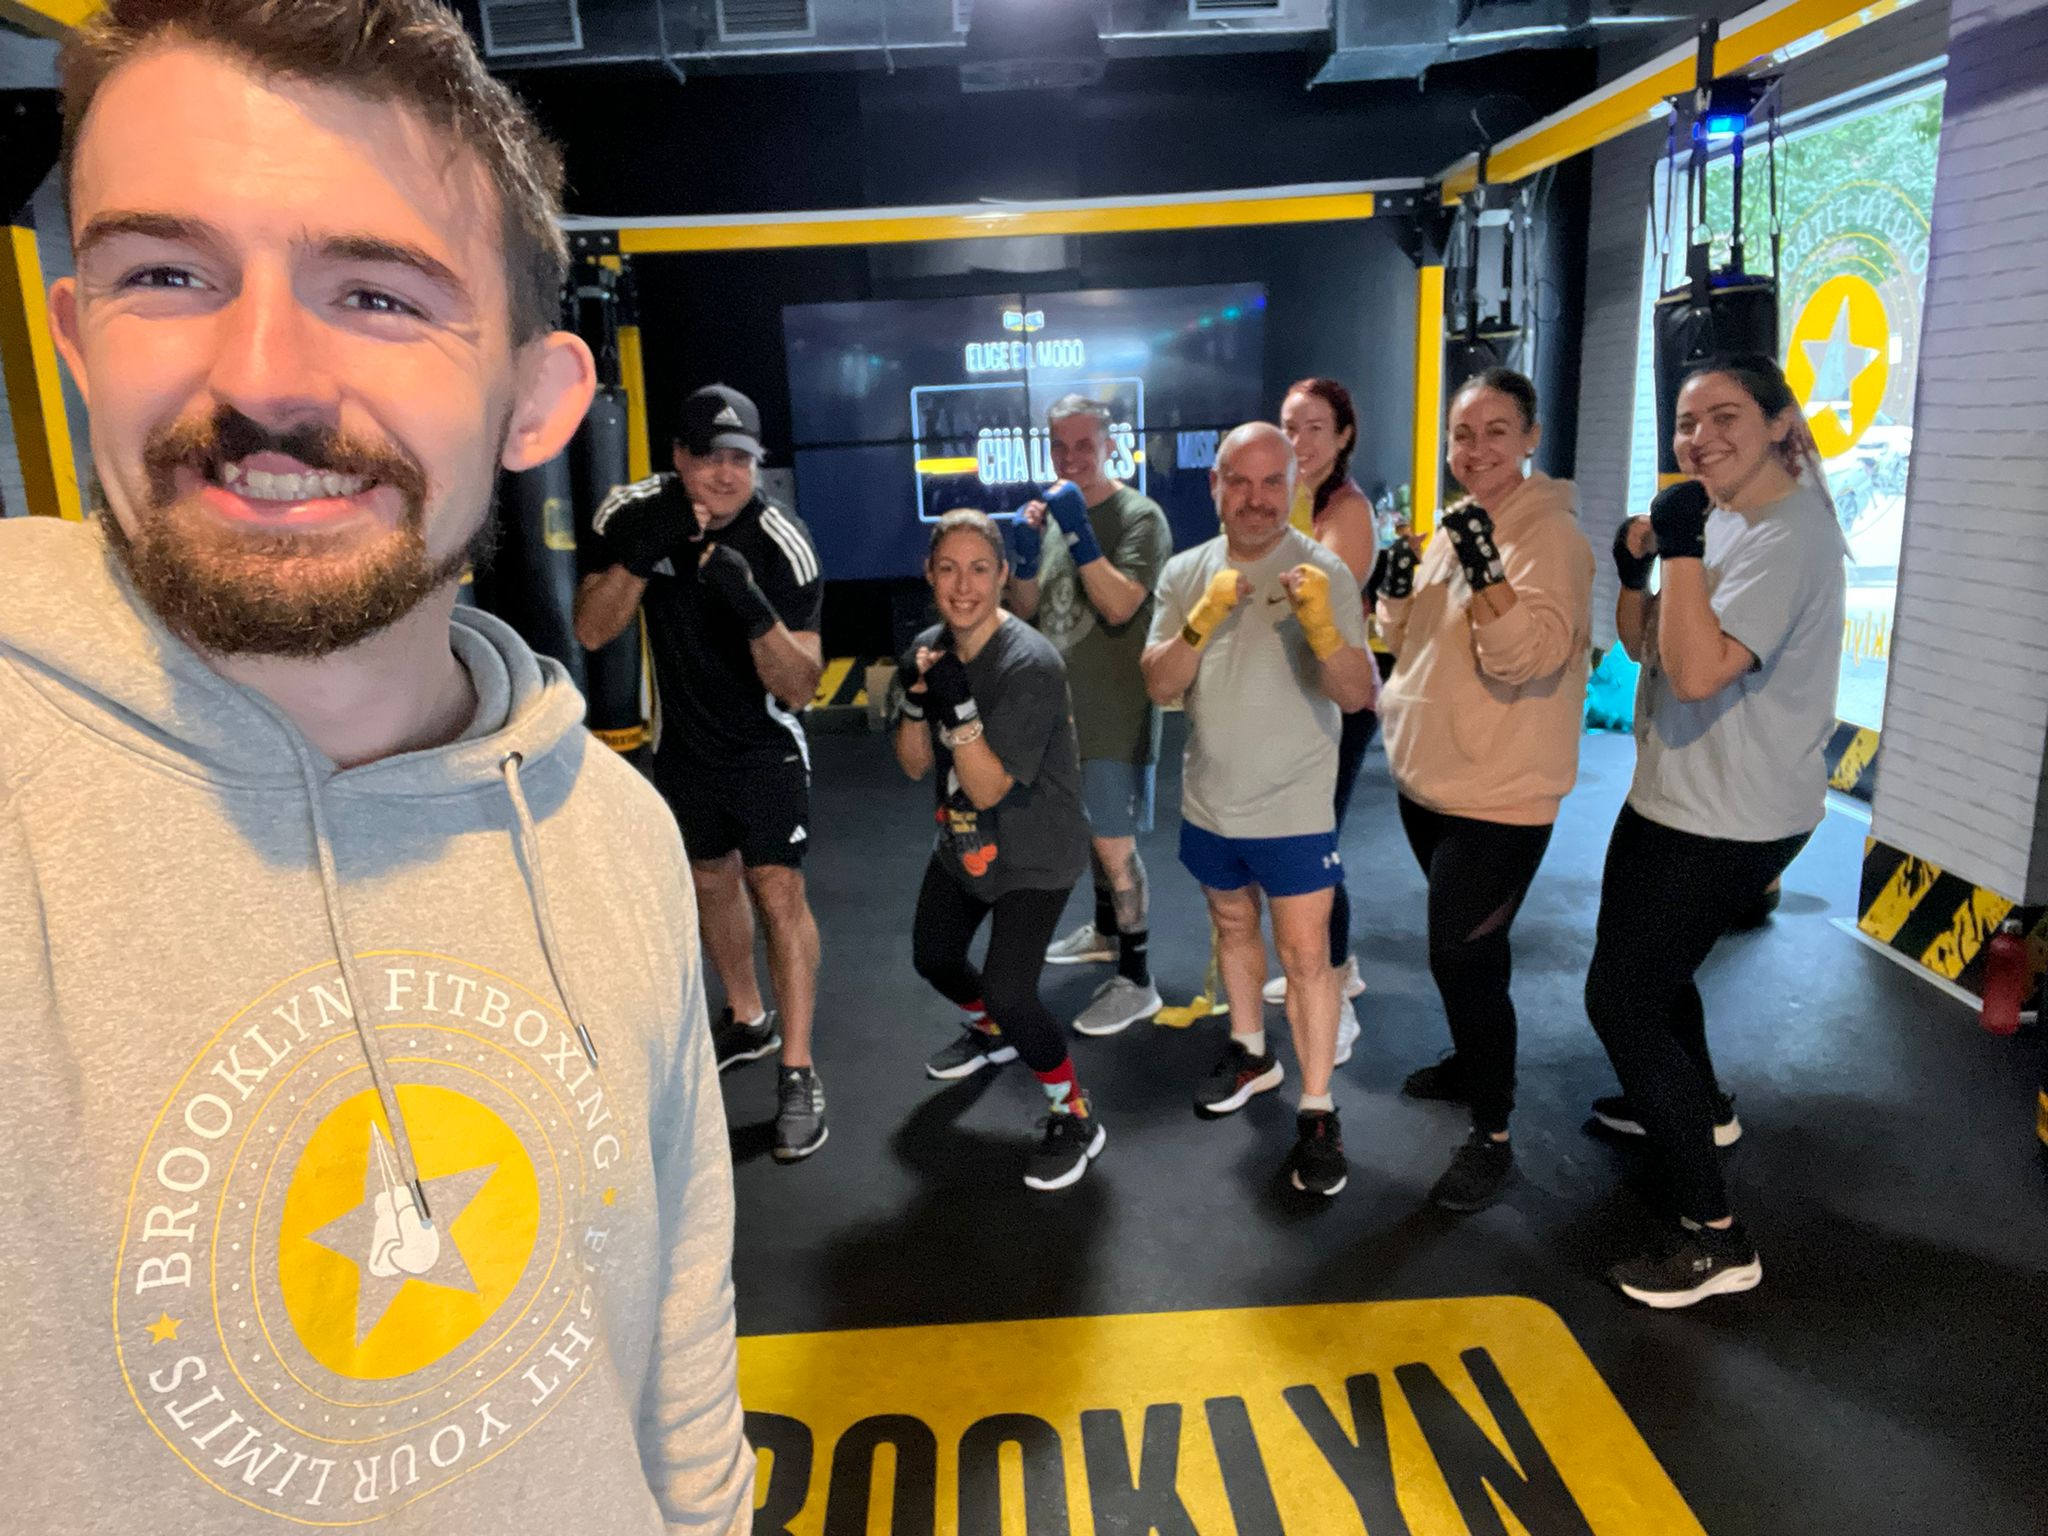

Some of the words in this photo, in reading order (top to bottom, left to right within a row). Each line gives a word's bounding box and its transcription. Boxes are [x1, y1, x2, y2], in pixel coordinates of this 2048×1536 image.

[135, 976, 354, 1295] BROOKLYN
[384, 969, 620, 1170] FITBOXING
[148, 1354, 338, 1506] LIMITS
[352, 1402, 512, 1505] YOUR
